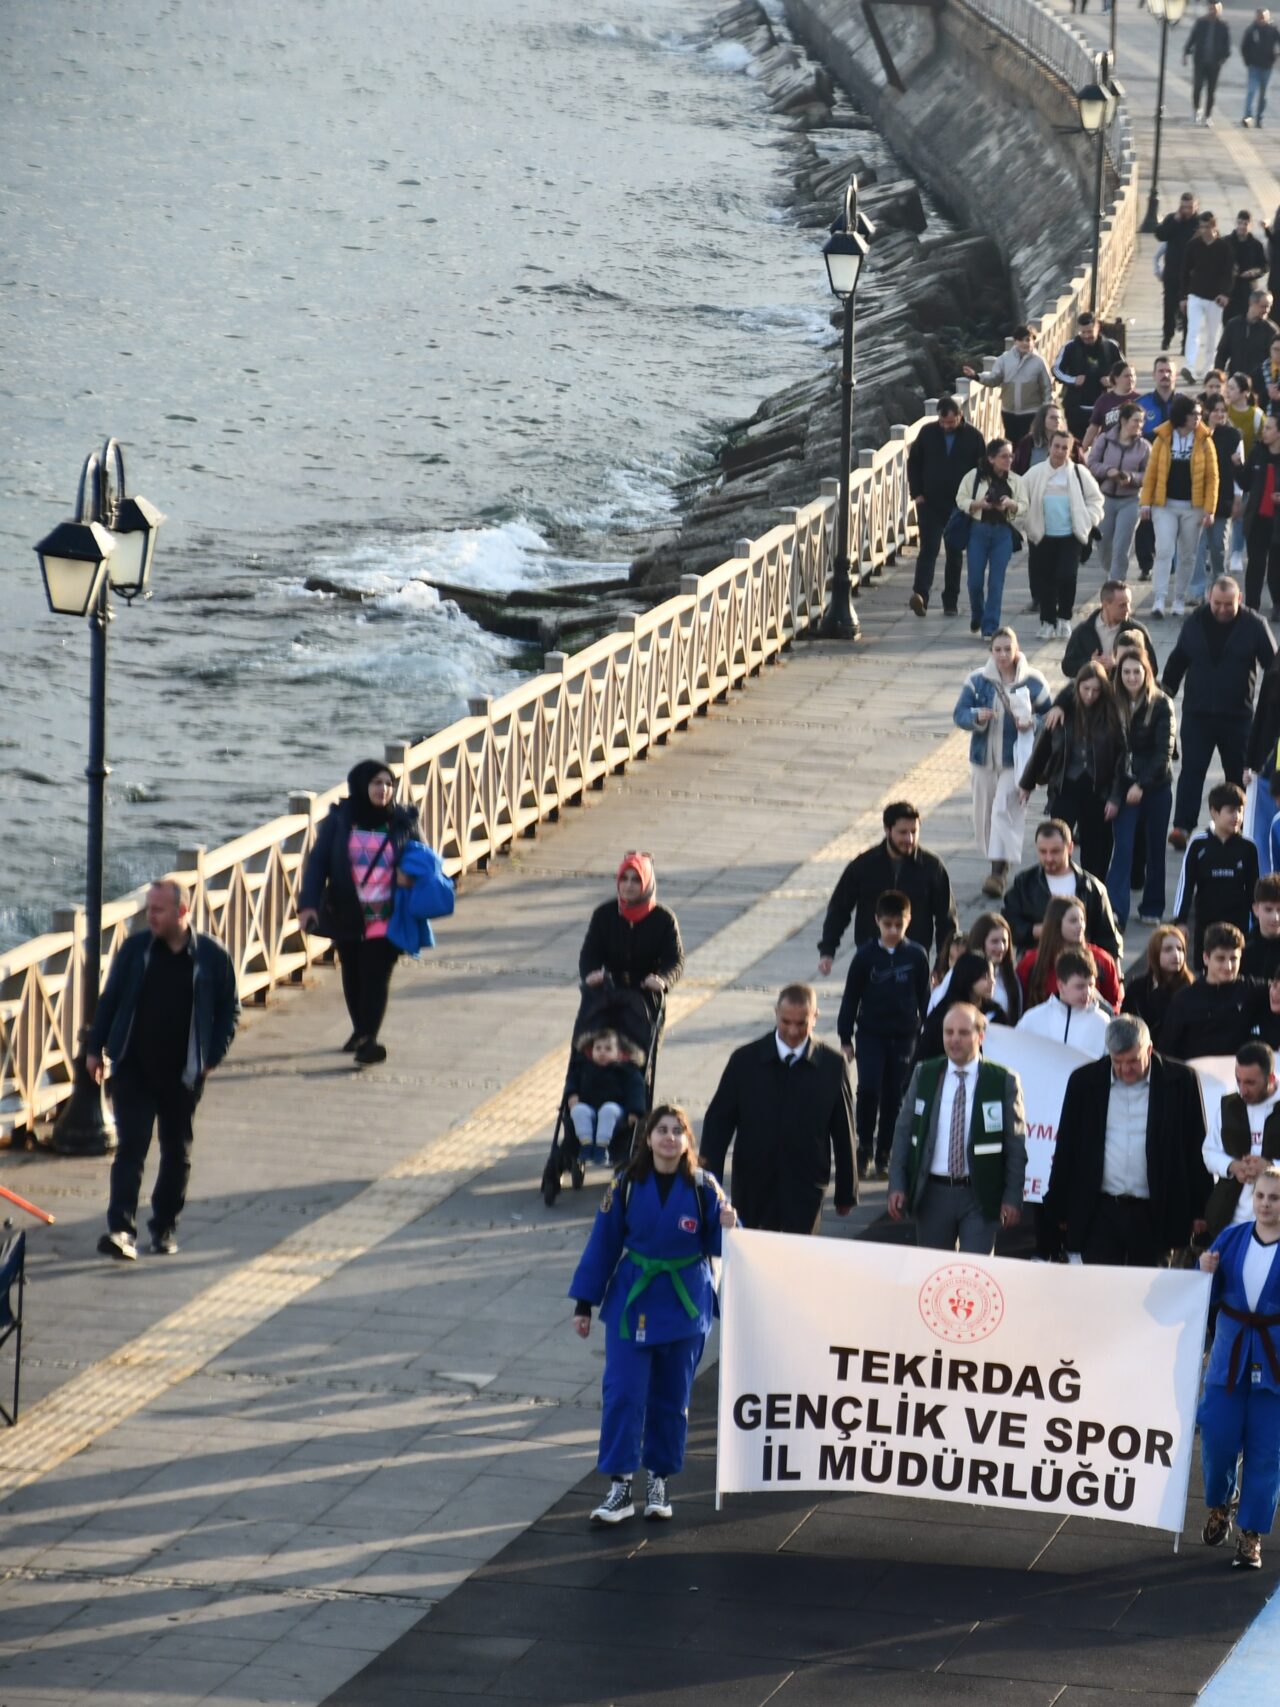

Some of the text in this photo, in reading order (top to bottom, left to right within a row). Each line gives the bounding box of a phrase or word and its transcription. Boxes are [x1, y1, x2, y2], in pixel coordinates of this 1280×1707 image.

[829, 1346, 1081, 1403] TEKİRDAĞ
[733, 1392, 1174, 1468] GENÇLİK VE SPOR
[762, 1435, 1136, 1511] İL MÜDÜRLÜĞÜ
